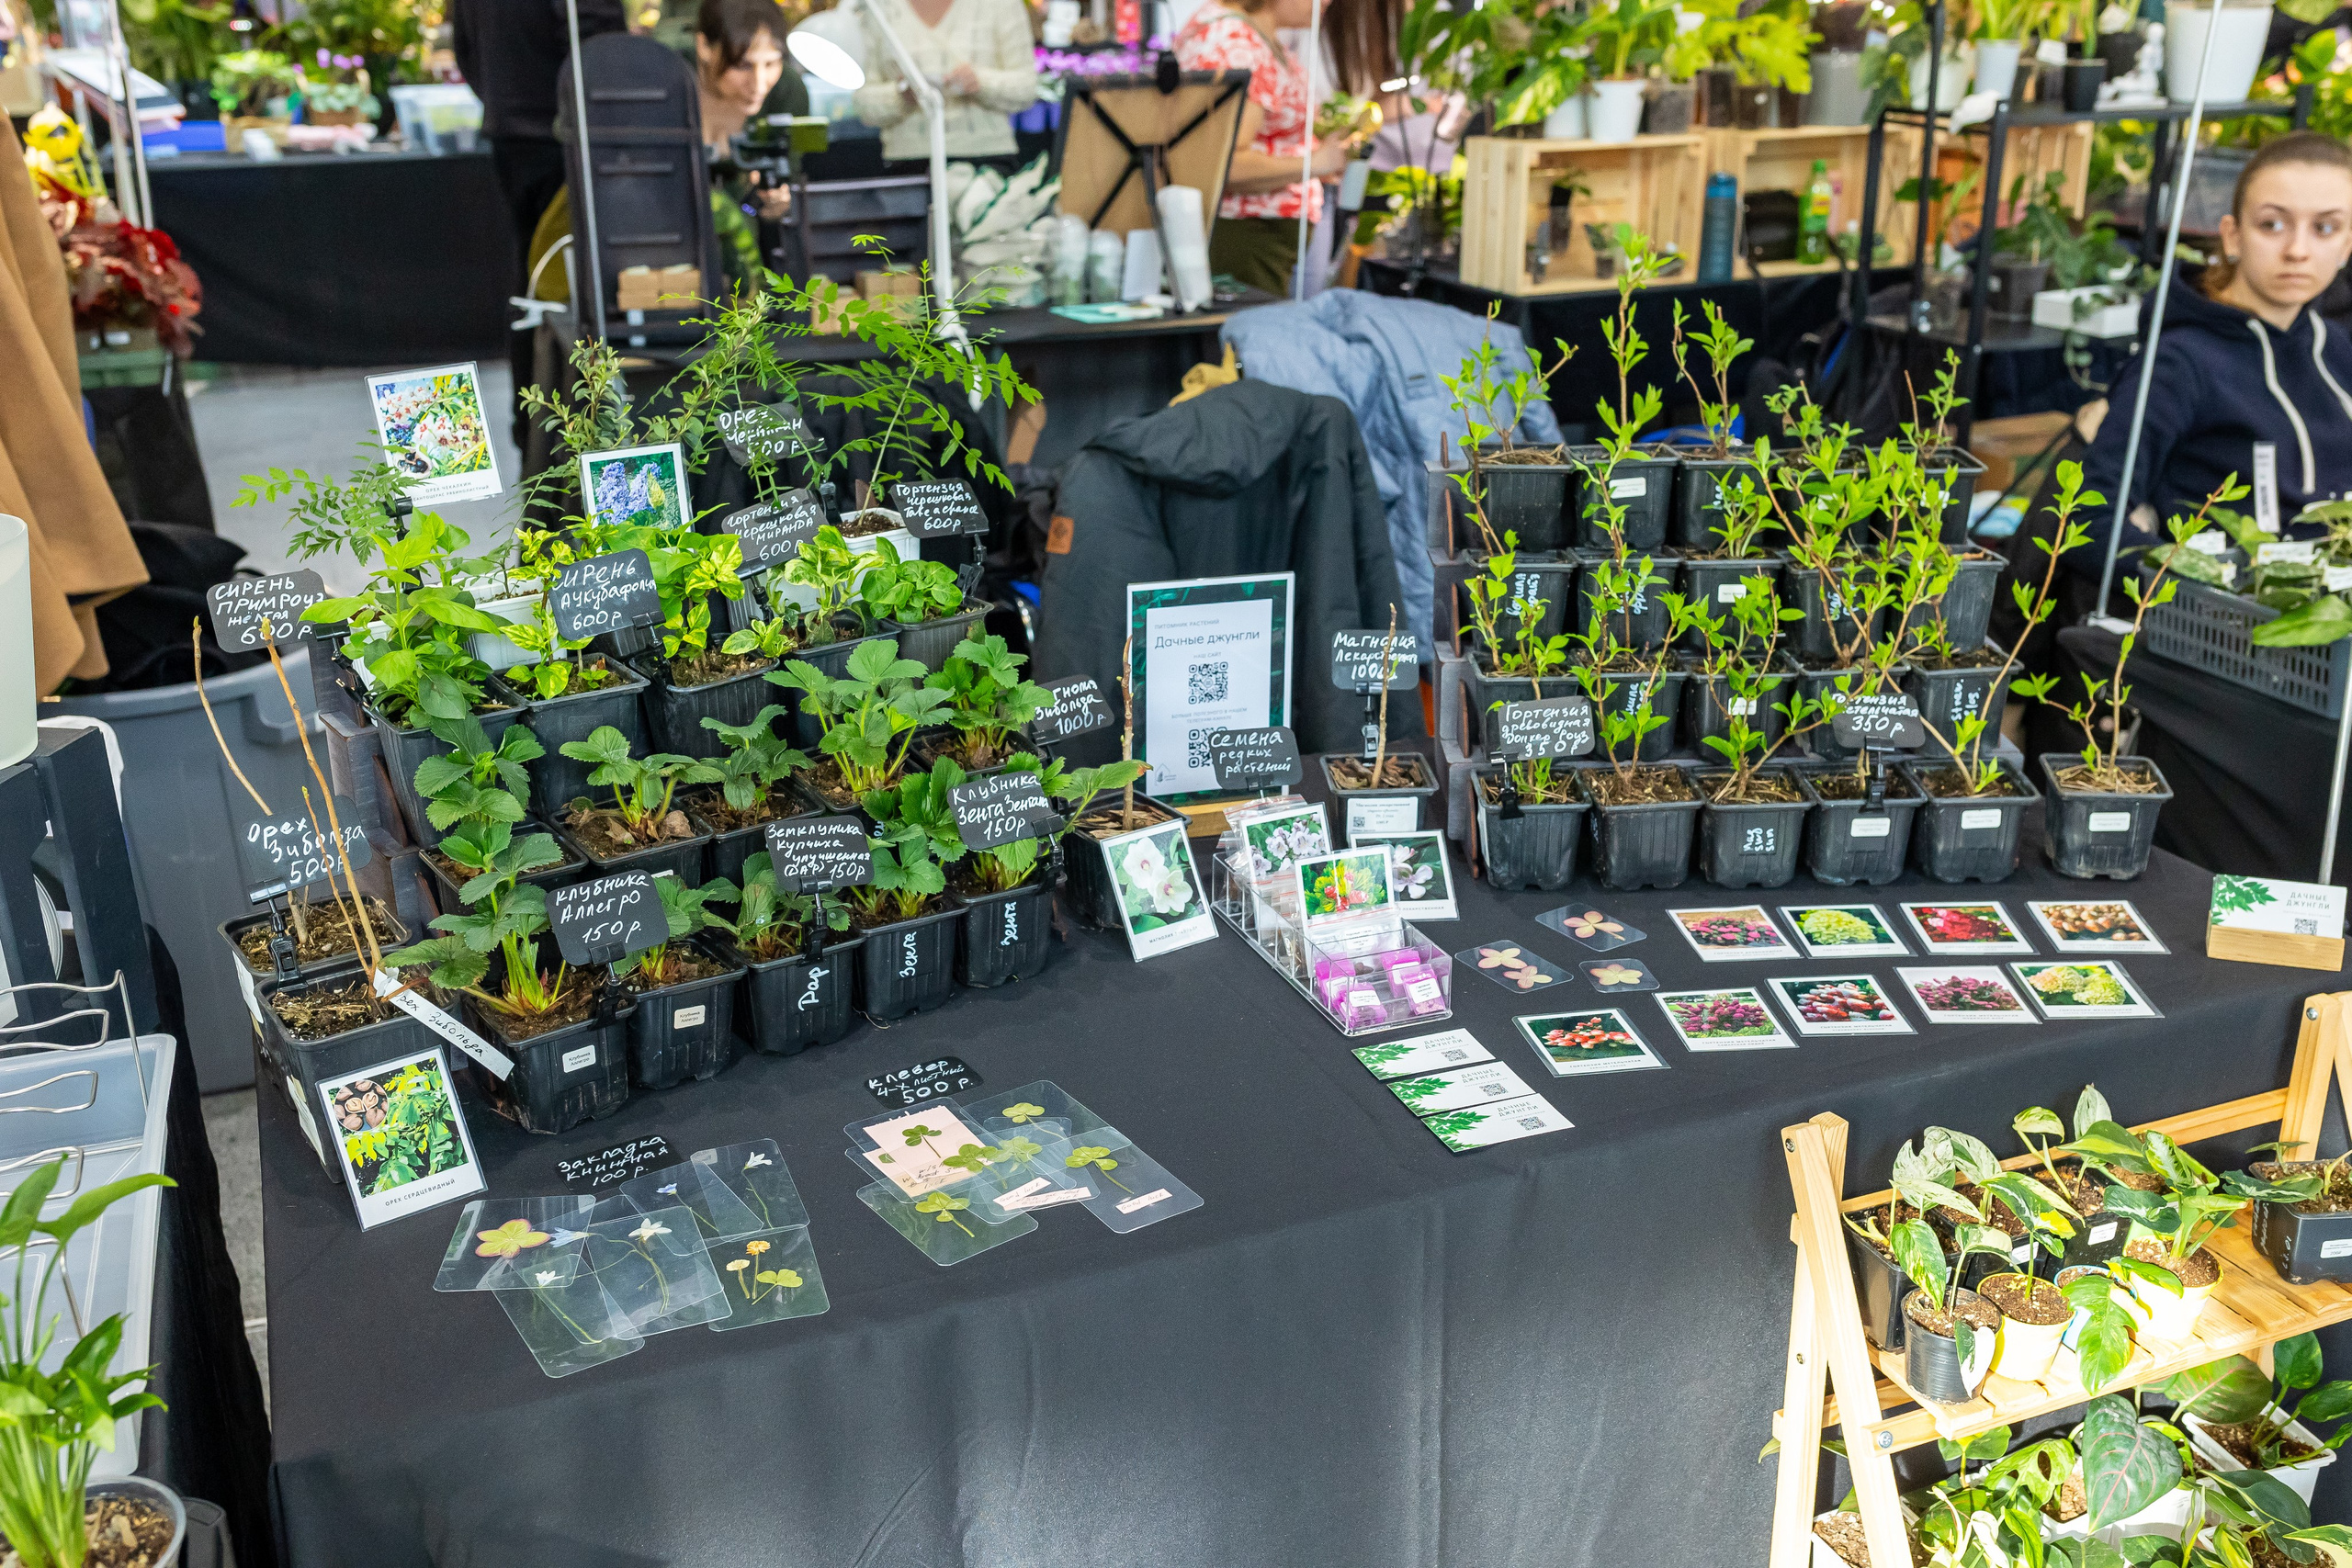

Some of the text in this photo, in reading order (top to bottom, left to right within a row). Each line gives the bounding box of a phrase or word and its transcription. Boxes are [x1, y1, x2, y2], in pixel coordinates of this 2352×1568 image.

[413, 491, 446, 502] САНТОЦЕРАС
[756, 517, 814, 545] МИРАНДА
[760, 540, 792, 560] 600
[215, 577, 295, 600] СИРЕНЬ
[573, 611, 608, 631] 600
[1155, 631, 1260, 649] Дачные джунгли
[1052, 680, 1098, 700] гнолия
[1842, 705, 1919, 717] етельчатая
[1055, 711, 1093, 735] 1000
[1851, 715, 1890, 732] 350
[1210, 730, 1283, 747] Семена
[1219, 748, 1272, 765] редких
[1525, 740, 1566, 758] 350
[1225, 757, 1292, 779] растений
[953, 775, 1041, 805] Клубника
[247, 818, 308, 849] Орех
[768, 824, 863, 839] Земклуника
[776, 840, 844, 859] Купчиха
[556, 874, 650, 907] Клубника
[2290, 892, 2327, 901] ДАЧНЫЕ
[560, 890, 640, 924] Аллегро
[2286, 900, 2330, 910] ДЖУНГЛИ
[1149, 933, 1173, 943] МАГНОЛИЯ
[679, 1011, 701, 1020] Клубника
[398, 994, 483, 1057] рех Зибольда
[568, 1051, 591, 1062] Клубника
[571, 1056, 590, 1066] Аллегро
[902, 1081, 949, 1103] 500
[593, 1168, 627, 1187] 100
[385, 1179, 456, 1207] ОРЕХ СЕРДЦЕВИДНЫЙ
